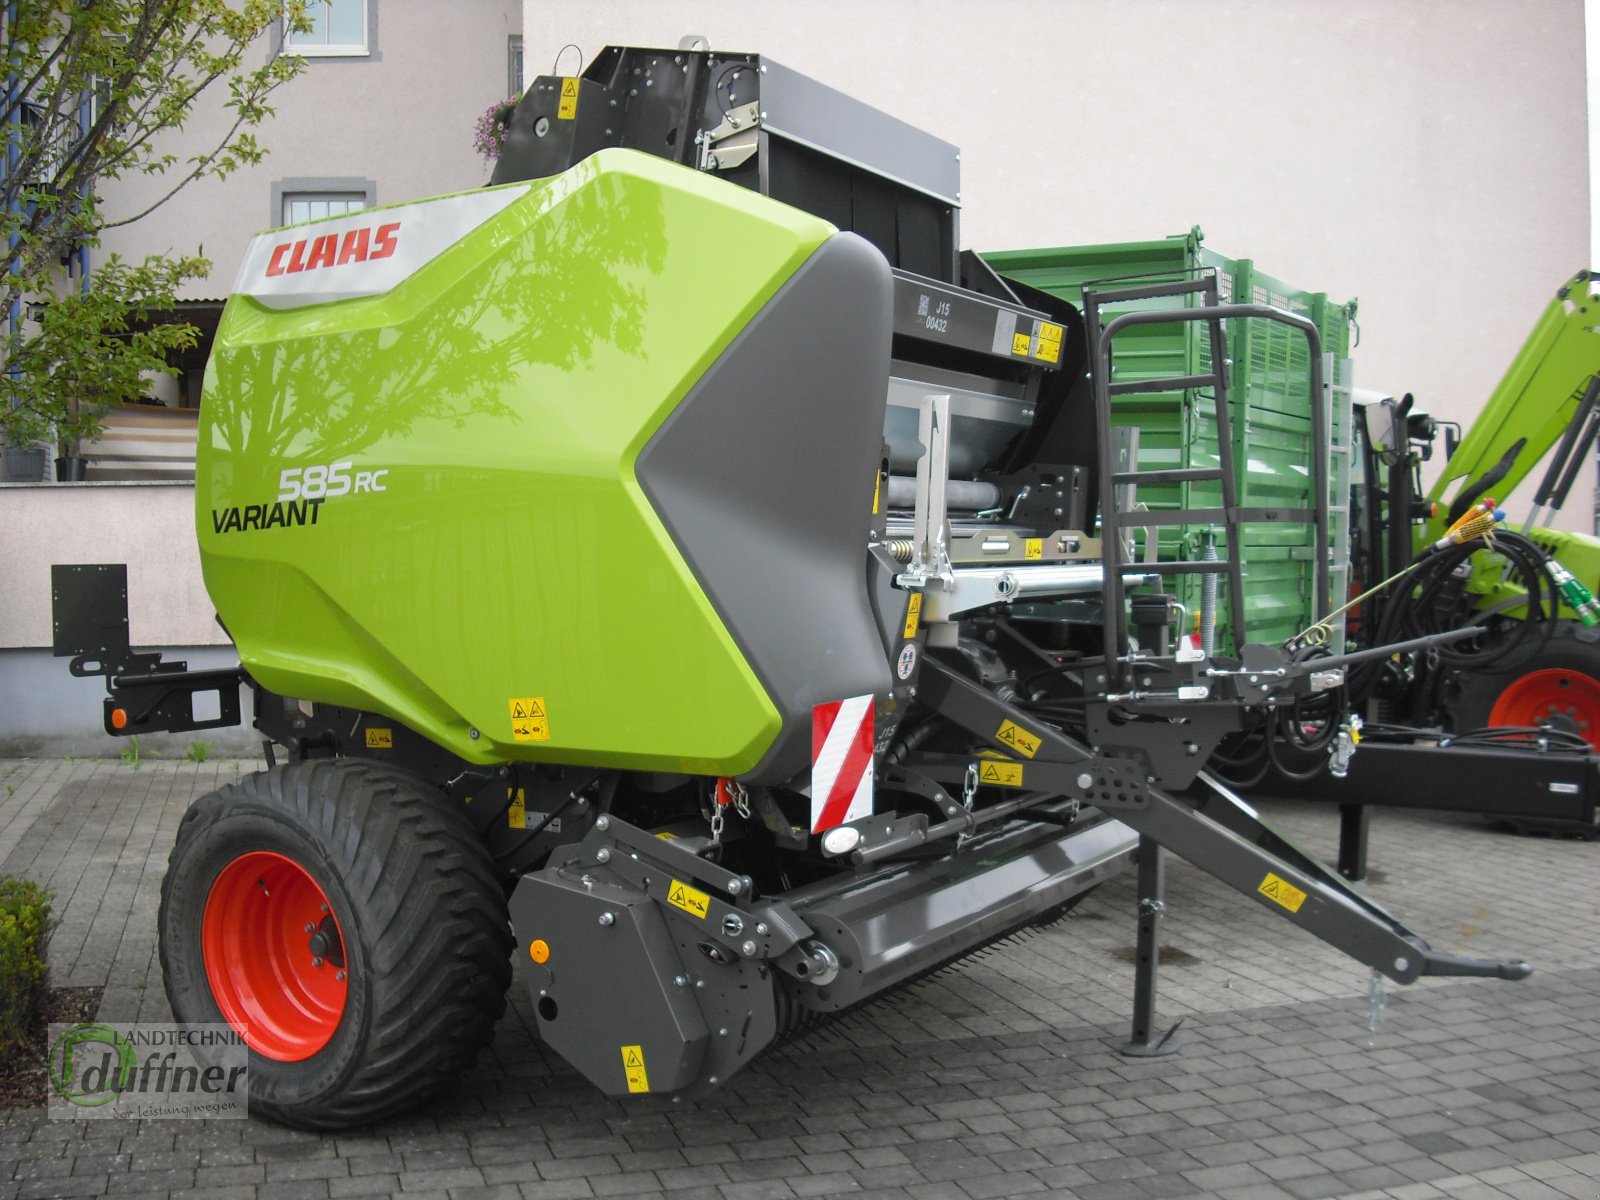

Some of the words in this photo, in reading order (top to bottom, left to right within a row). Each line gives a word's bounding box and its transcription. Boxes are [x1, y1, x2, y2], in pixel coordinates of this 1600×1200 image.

[265, 222, 401, 277] CLAAS
[925, 316, 947, 332] 00432
[936, 301, 950, 315] J15
[277, 462, 352, 502] 585
[354, 469, 389, 493] RC
[212, 498, 325, 534] VARIANT
